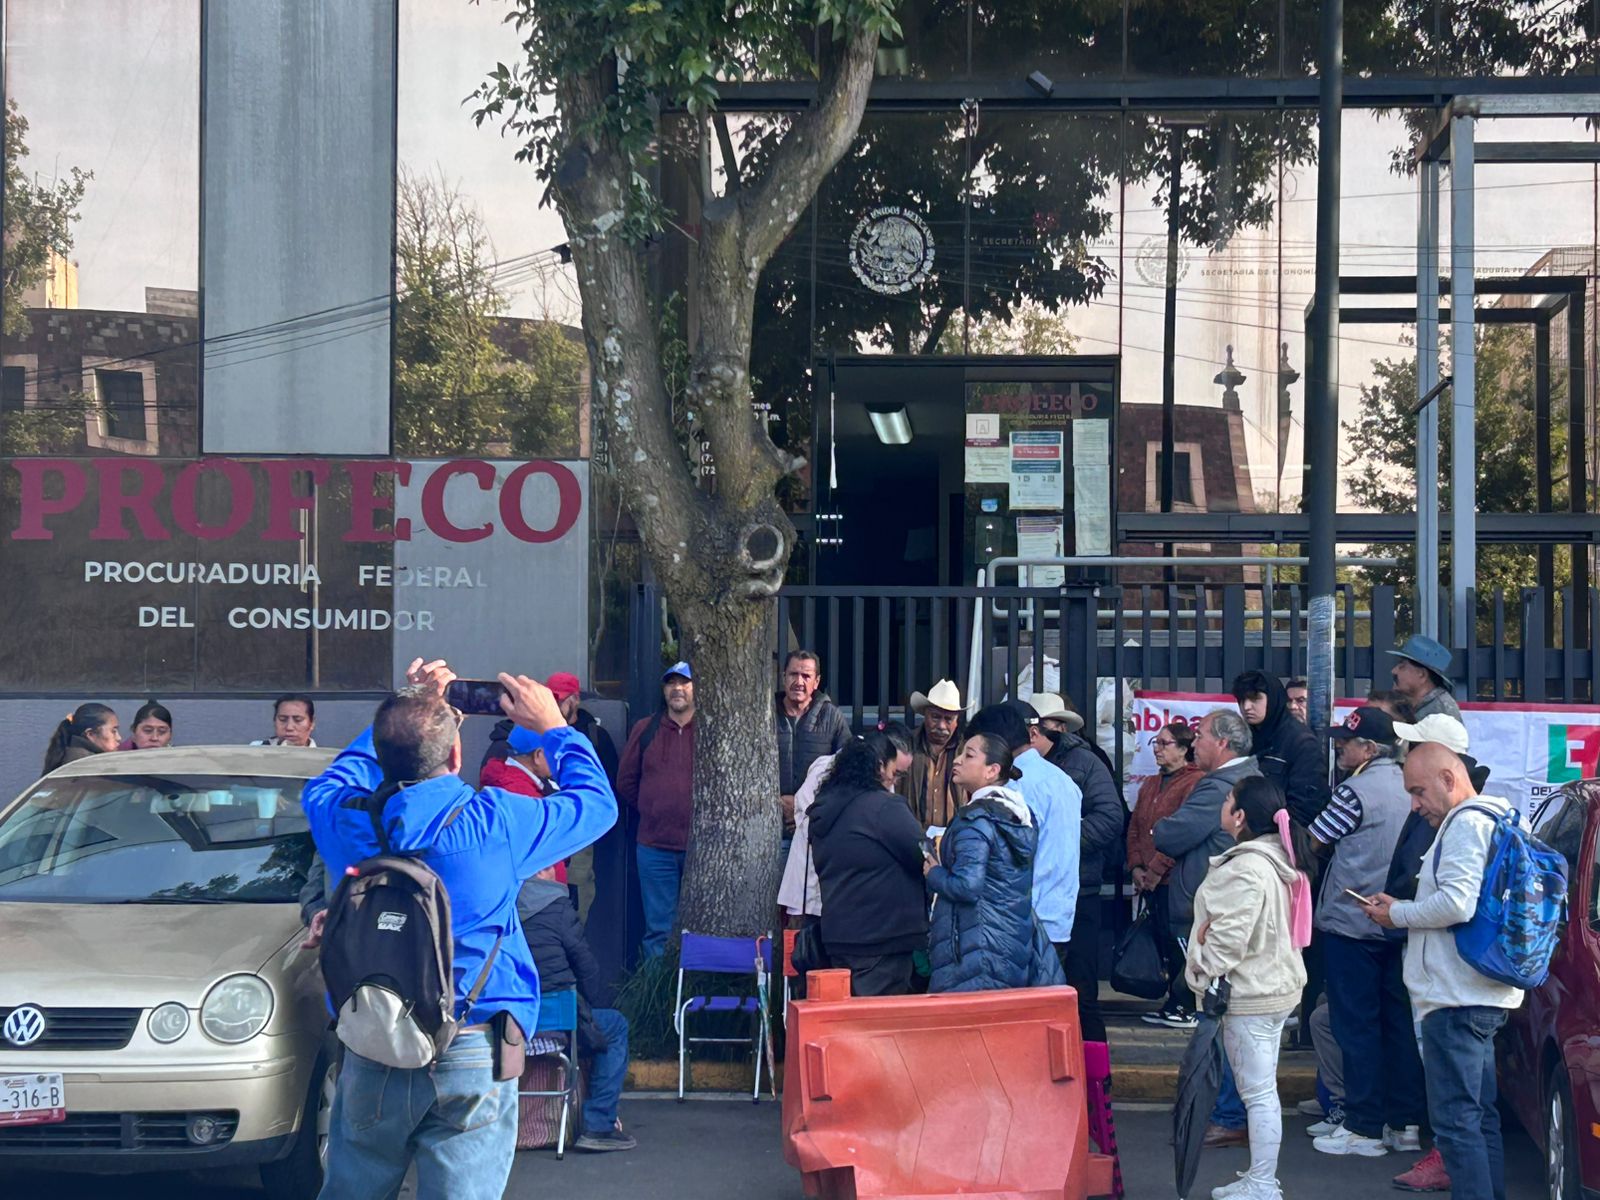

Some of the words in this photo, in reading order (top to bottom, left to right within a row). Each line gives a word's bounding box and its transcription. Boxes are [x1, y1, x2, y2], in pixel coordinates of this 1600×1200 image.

[10, 457, 582, 543] PROFECO
[84, 561, 321, 585] PROCURADURIA
[358, 565, 487, 588] FEDERAL
[139, 606, 195, 628] DEL
[228, 607, 434, 631] CONSUMIDOR
